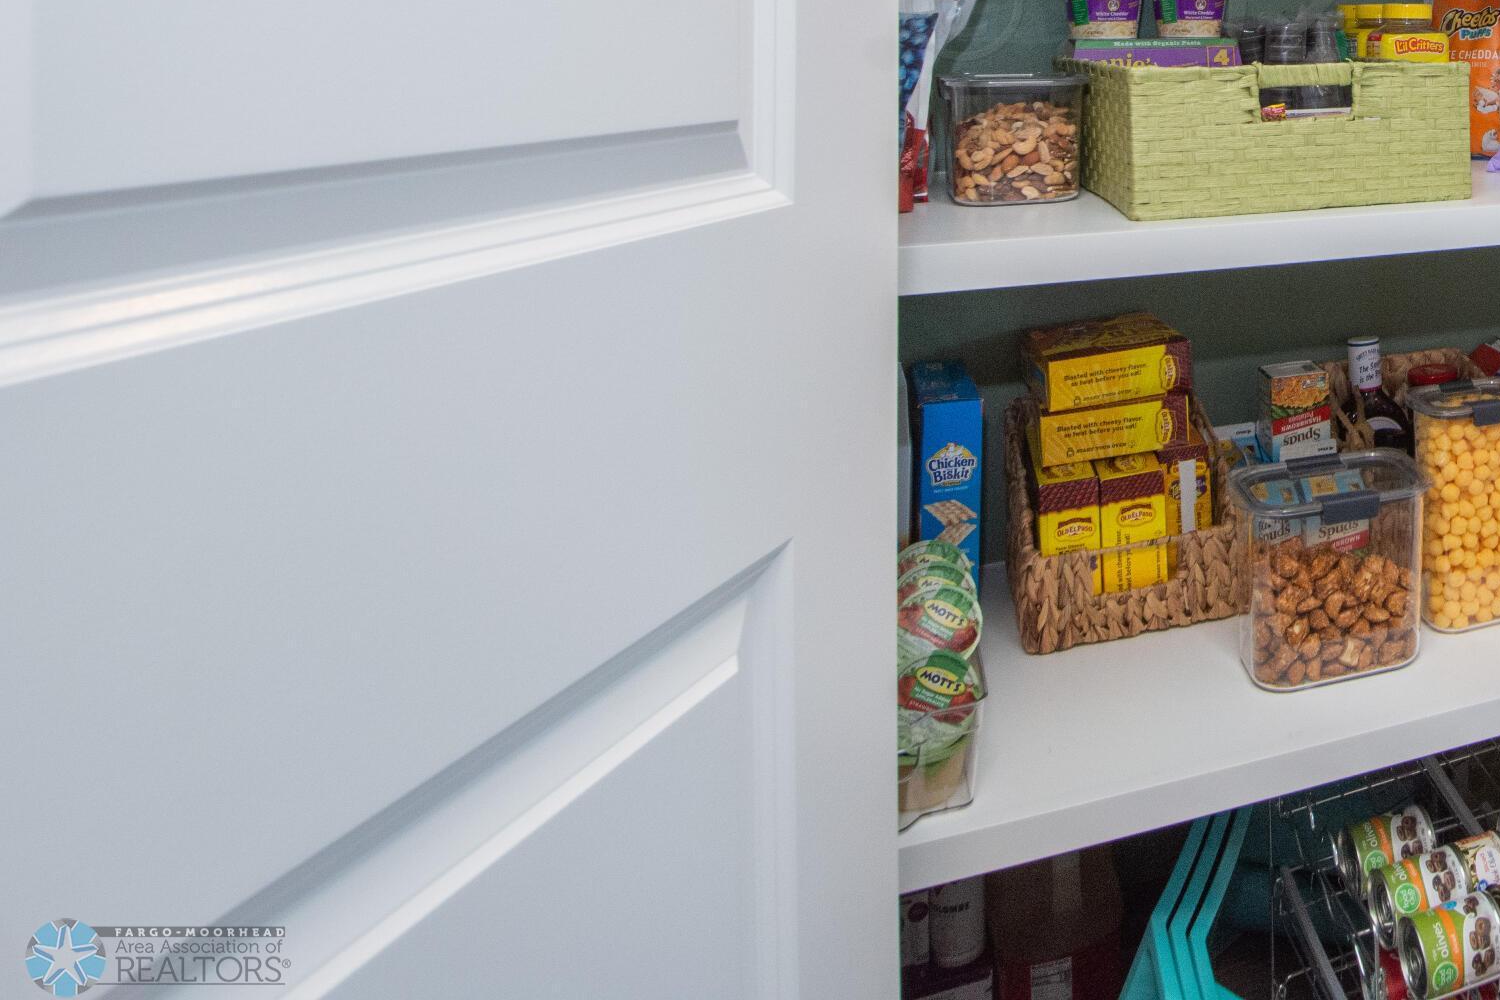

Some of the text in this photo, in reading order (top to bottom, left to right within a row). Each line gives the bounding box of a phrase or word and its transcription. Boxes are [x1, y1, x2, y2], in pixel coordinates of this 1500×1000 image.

[1440, 8, 1500, 35] Cheetos
[1407, 38, 1444, 53] Critters
[1213, 48, 1231, 66] 4
[1089, 369, 1104, 378] with
[1095, 375, 1116, 385] before
[1083, 421, 1098, 430] with
[1099, 418, 1122, 428] cheesy
[1089, 426, 1111, 436] before
[1111, 424, 1125, 434] you
[1283, 427, 1321, 447] Spuds
[928, 457, 975, 472] Chicken
[933, 468, 970, 484] Biskit
[928, 602, 965, 626] MOTT'S
[920, 670, 962, 693] MOTT'S
[1432, 922, 1449, 958] olives
